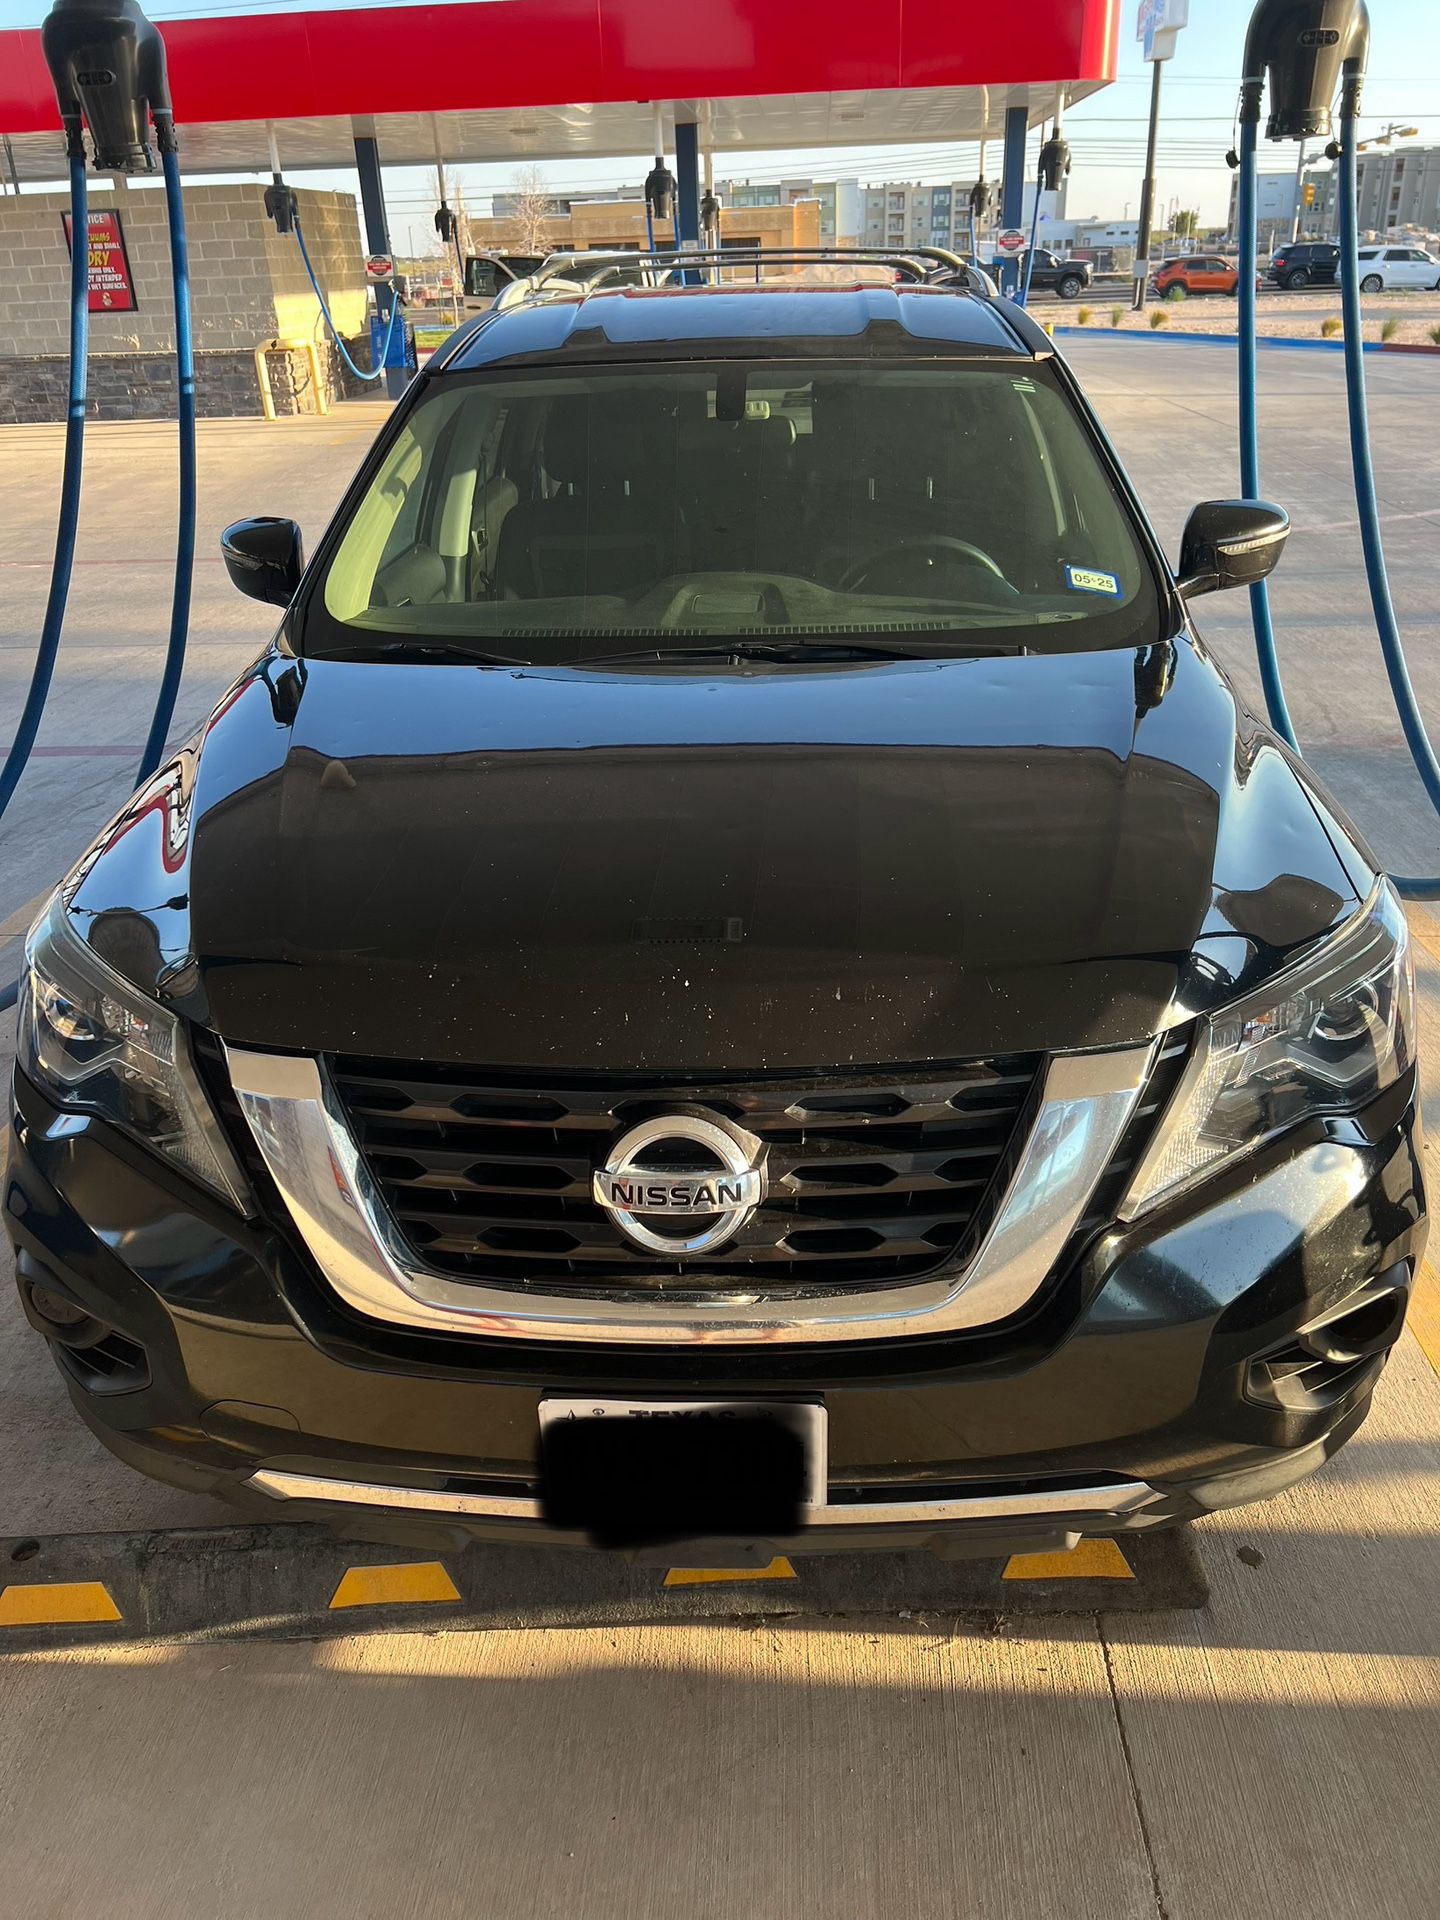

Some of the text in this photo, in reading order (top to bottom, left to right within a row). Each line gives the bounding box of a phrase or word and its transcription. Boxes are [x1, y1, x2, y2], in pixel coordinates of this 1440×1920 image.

[87, 250, 110, 266] DRY
[95, 274, 122, 282] INTENDED
[611, 1182, 742, 1206] NISSAN
